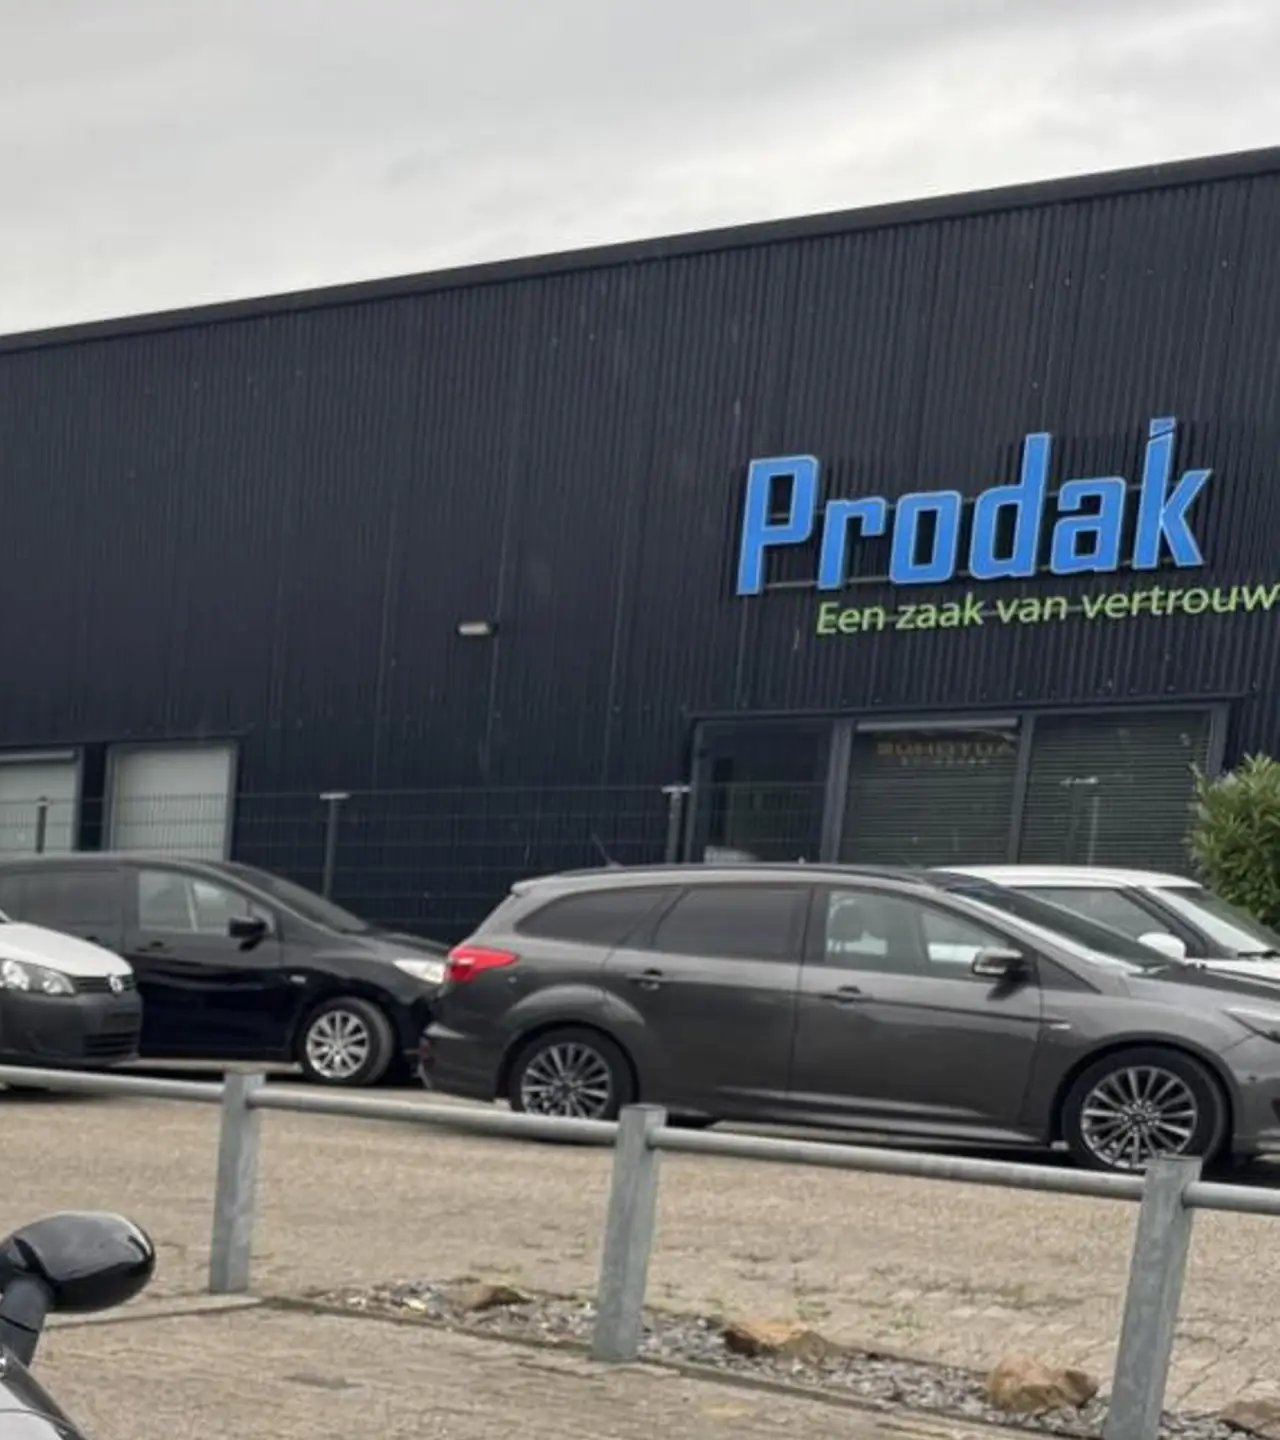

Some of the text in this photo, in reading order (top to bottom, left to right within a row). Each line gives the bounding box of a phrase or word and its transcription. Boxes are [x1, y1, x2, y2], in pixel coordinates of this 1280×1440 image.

[737, 416, 1212, 595] Prodak
[816, 601, 884, 635] Een
[894, 592, 984, 630] zaak
[997, 595, 1068, 623] van
